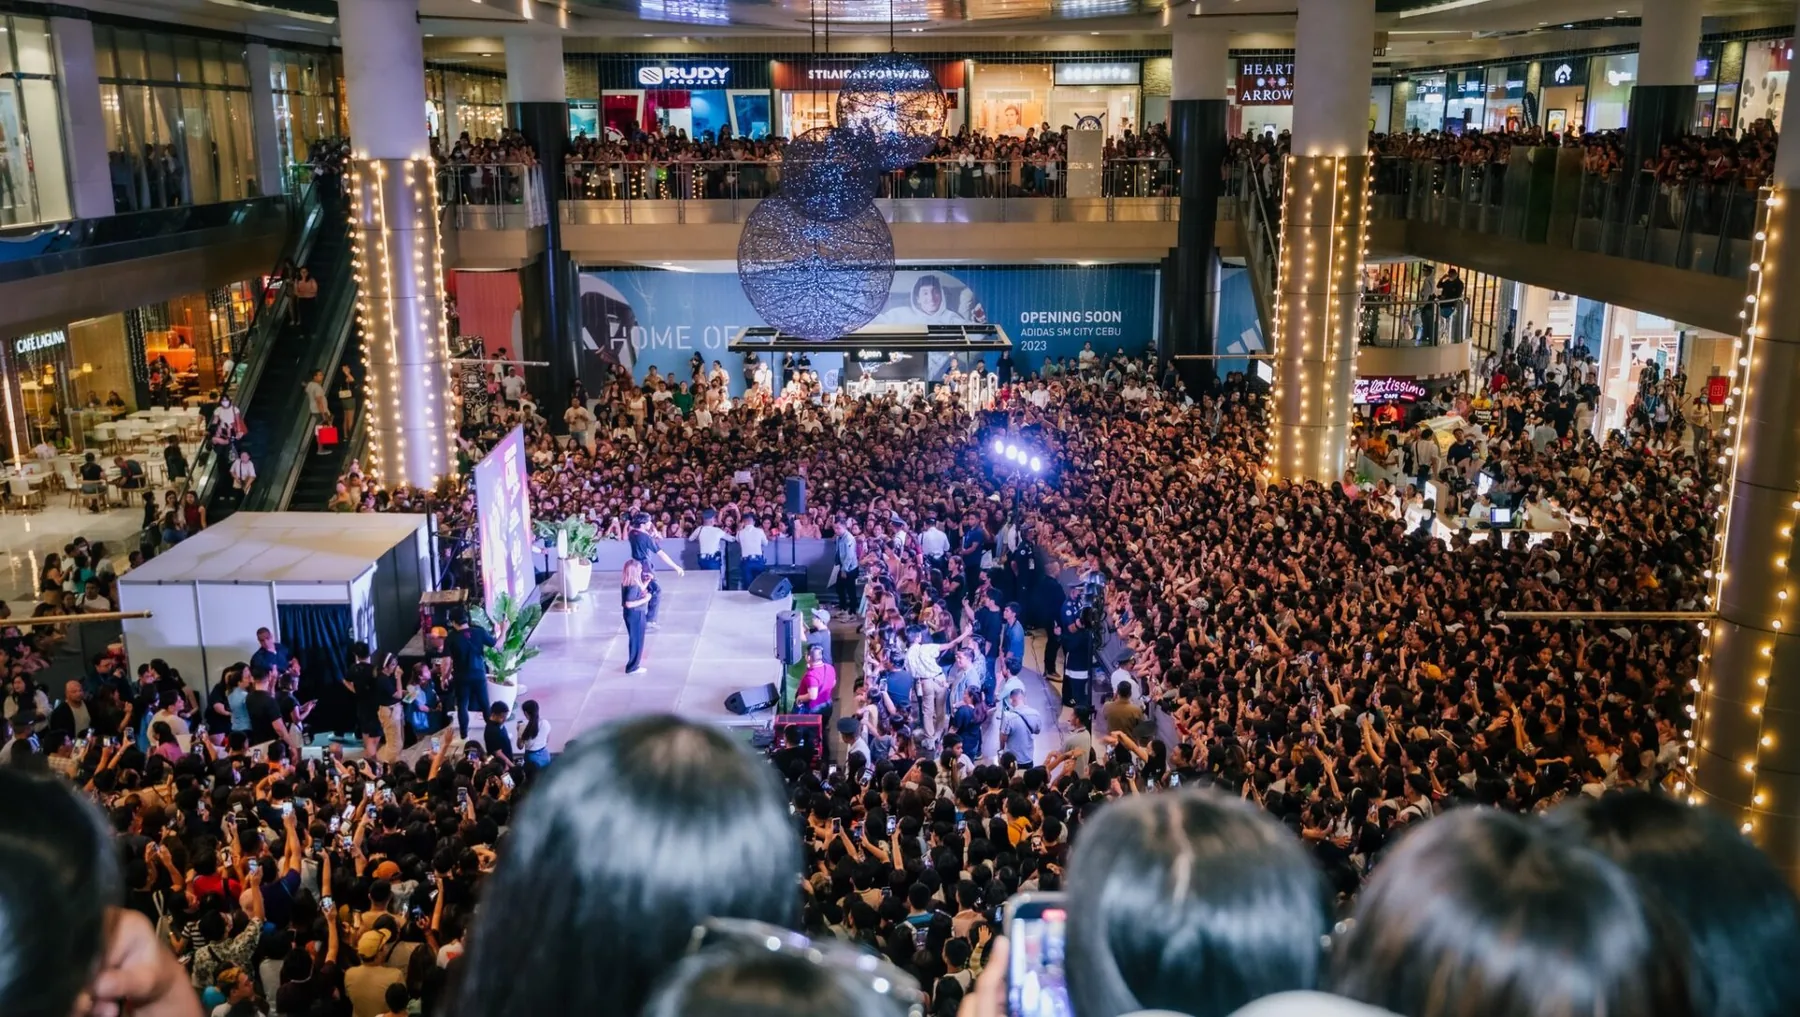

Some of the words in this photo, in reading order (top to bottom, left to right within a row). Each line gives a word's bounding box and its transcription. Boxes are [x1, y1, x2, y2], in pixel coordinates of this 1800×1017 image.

[664, 67, 730, 79] RUDY
[1243, 64, 1294, 75] HEART
[1242, 89, 1294, 101] ARROW
[1020, 311, 1081, 324] OPENING
[1084, 311, 1122, 323] SOON
[611, 325, 692, 350] HOME
[1020, 328, 1055, 337] ADIDAS
[1057, 328, 1071, 337] SM
[1073, 327, 1093, 336] CITY
[1095, 327, 1121, 336] CEBU
[36, 330, 66, 350] LAGUNA
[1021, 340, 1047, 351] 2023
